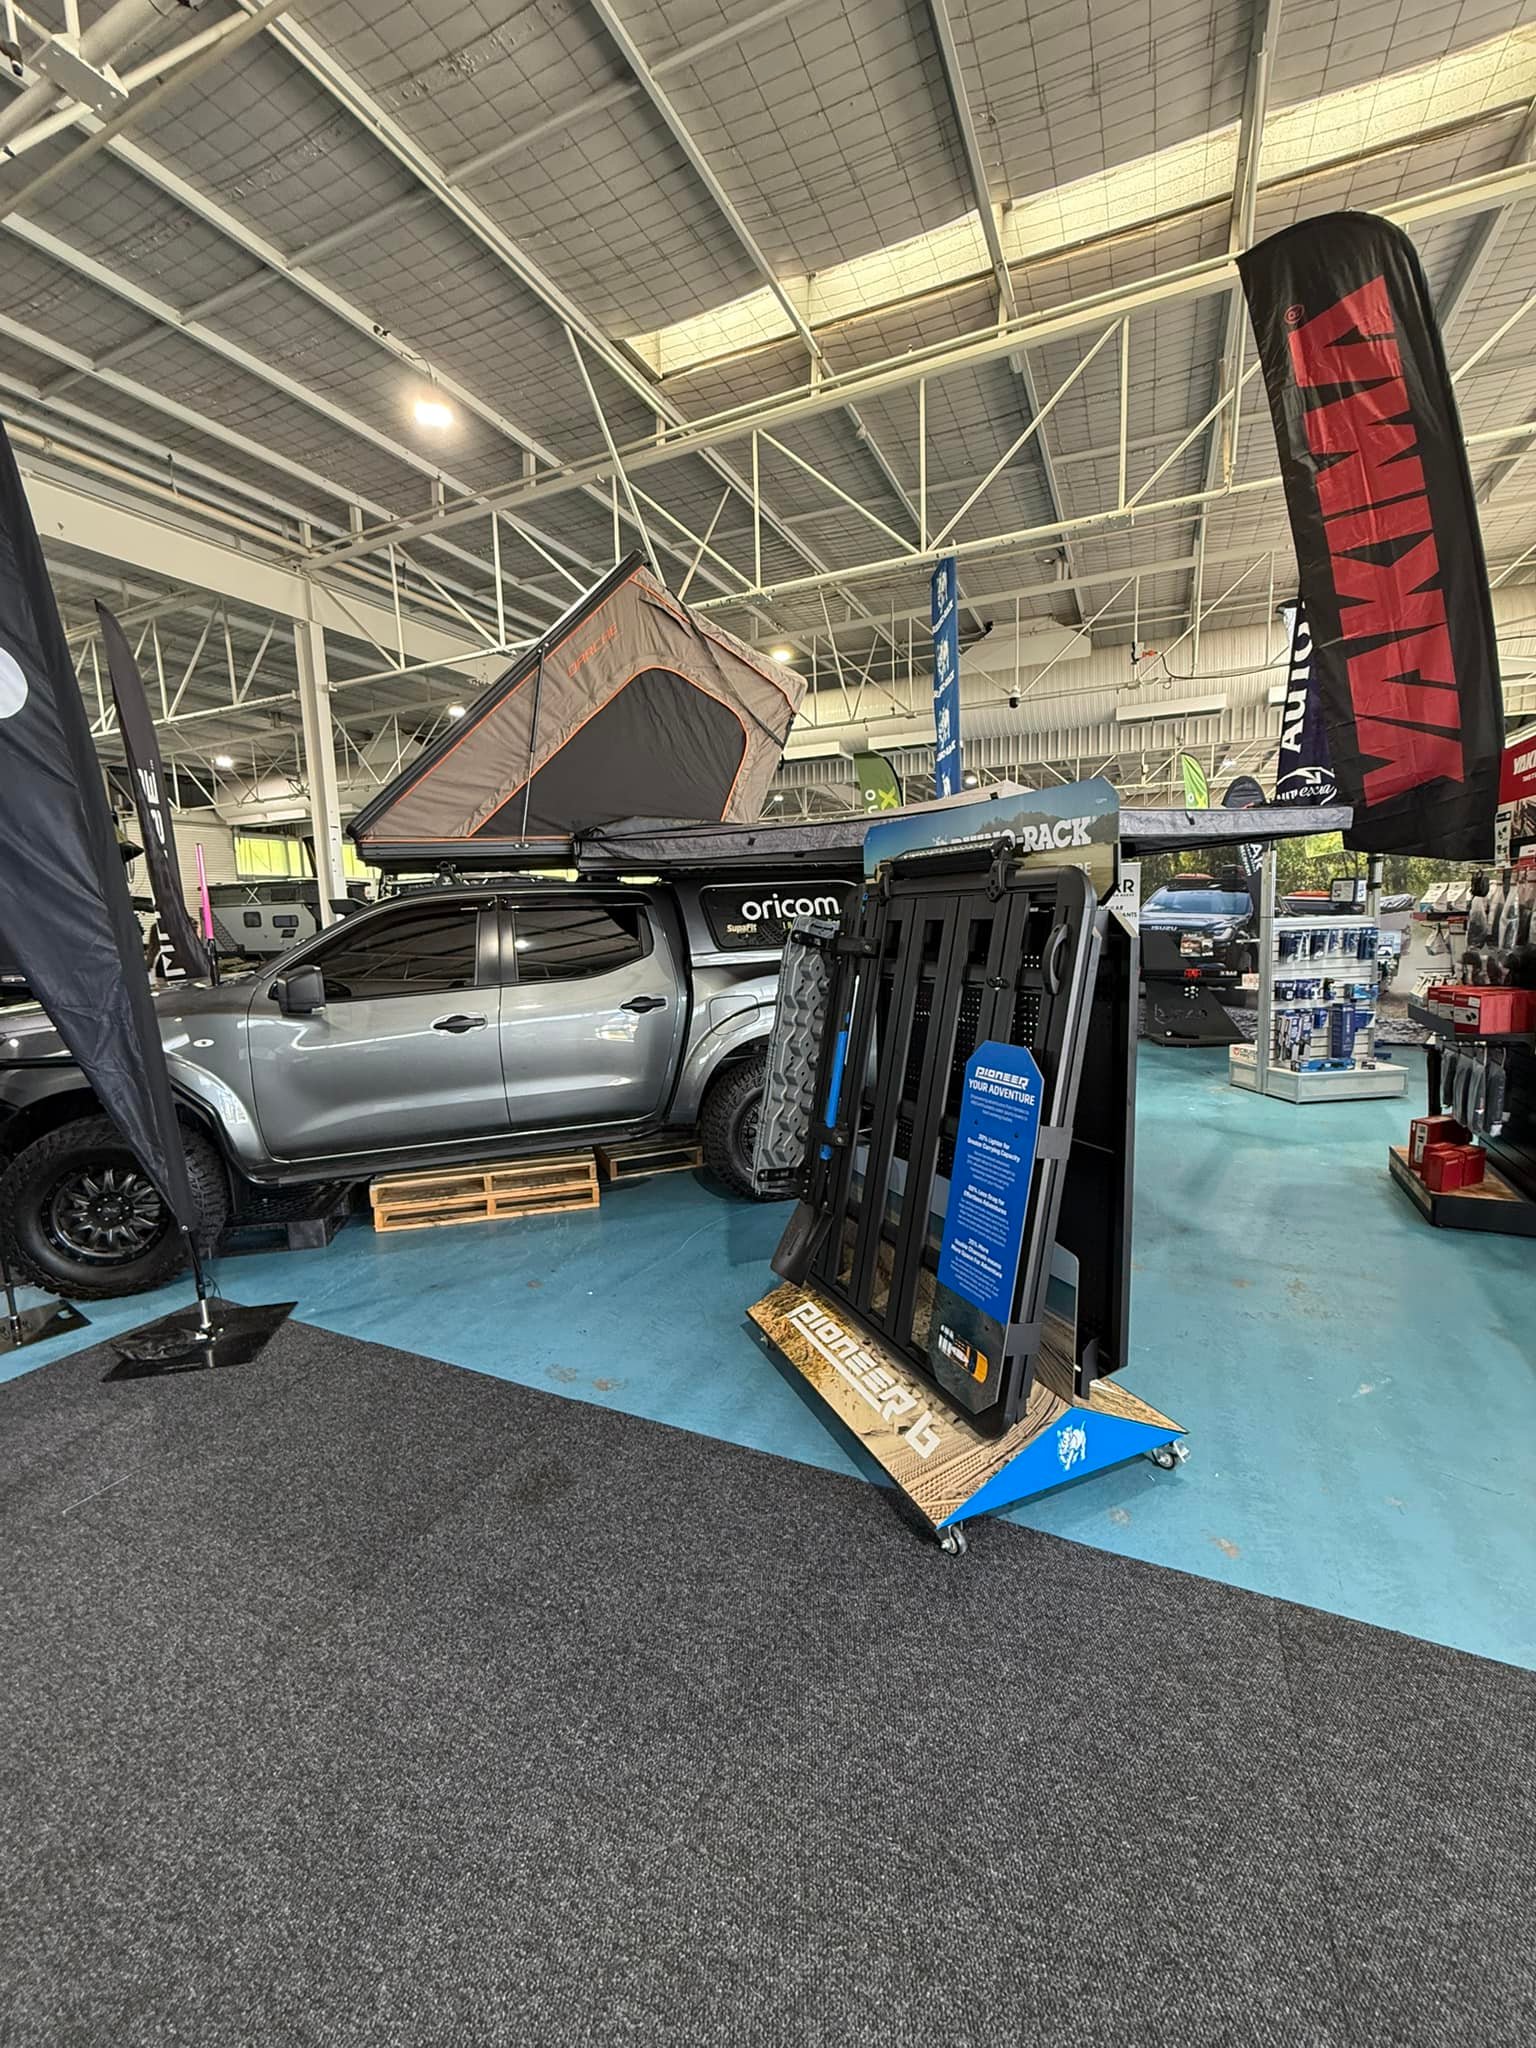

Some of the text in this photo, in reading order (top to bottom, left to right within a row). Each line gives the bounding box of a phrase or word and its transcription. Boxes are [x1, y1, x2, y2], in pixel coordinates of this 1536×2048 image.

[1286, 273, 1465, 808] YAKIMA
[741, 892, 840, 921] oricom
[968, 1078, 1036, 1106] YOUR ADVENTURE
[975, 1066, 1029, 1090] PIONEER
[786, 1300, 918, 1422] PIONEER
